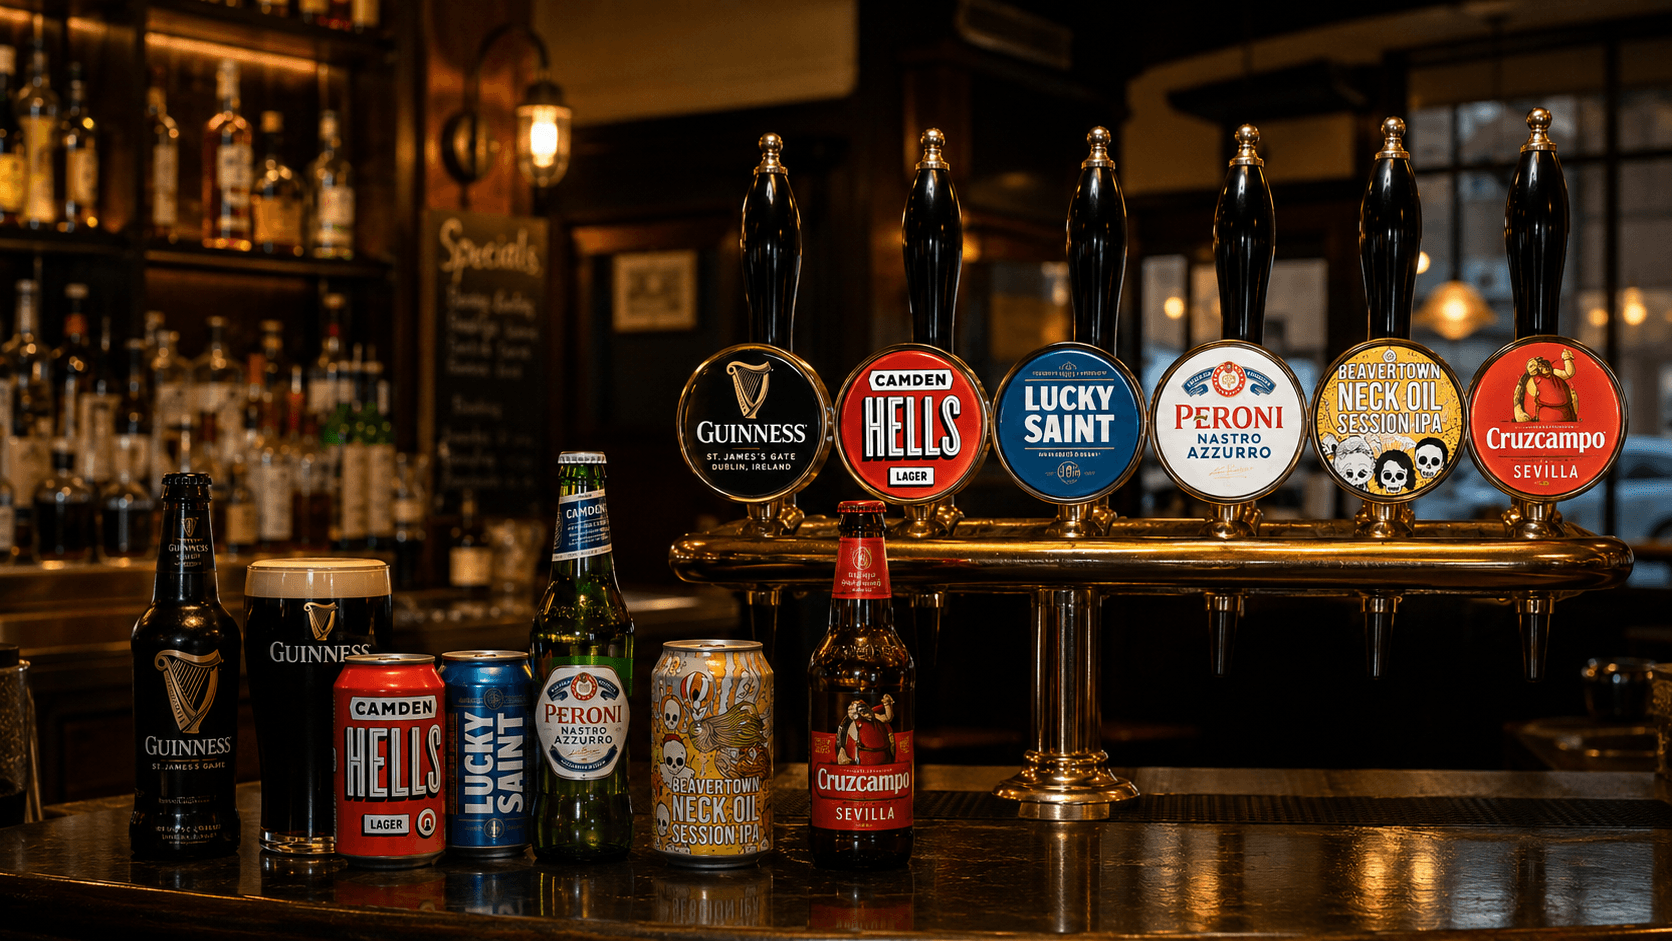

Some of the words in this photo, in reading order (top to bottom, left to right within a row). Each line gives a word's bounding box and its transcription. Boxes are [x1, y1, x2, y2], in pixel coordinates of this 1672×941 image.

[875, 373, 947, 386] CAMDEN
[1338, 363, 1441, 380] BEAVERTOWN
[1025, 385, 1115, 411] LUCKY
[1337, 382, 1401, 412] NECK
[1407, 381, 1443, 412] OIL
[1174, 404, 1284, 430] PERONI
[1337, 414, 1411, 434] SESSION
[1414, 414, 1443, 434] IPA
[696, 420, 806, 443] GUINNESS
[863, 396, 962, 459] HELLS
[1024, 414, 1115, 443] SAINT
[1197, 433, 1262, 444] NASTRO
[1486, 427, 1605, 453] Cruzcampo
[706, 452, 721, 461] ST.
[723, 452, 767, 461] JAMES'S
[770, 452, 796, 461] GATE
[1187, 446, 1271, 459] AZZURRO
[712, 463, 748, 471] DUBLIN,
[752, 463, 791, 471] IRELAND
[896, 471, 927, 482] LAGER
[1513, 464, 1579, 478] SEVILLA
[566, 503, 605, 519] CAMDEN
[355, 700, 433, 716] CAMDEN
[544, 703, 622, 724] PERONI
[554, 735, 613, 745] AZZURRO
[561, 726, 607, 735] NASTRO
[145, 735, 231, 756] GUINNESS
[346, 724, 441, 798] HELLS
[464, 711, 494, 814] LUCKY
[497, 713, 524, 814] SAINT
[672, 777, 760, 794] BEAVERTOWN
[817, 767, 910, 794] Cruzcampo
[672, 795, 726, 823] NECK
[733, 794, 760, 823] OIL
[835, 806, 895, 821] SEVILLA
[370, 819, 403, 830] LAGER
[671, 824, 736, 846] SESSION
[738, 824, 760, 844] IPA
